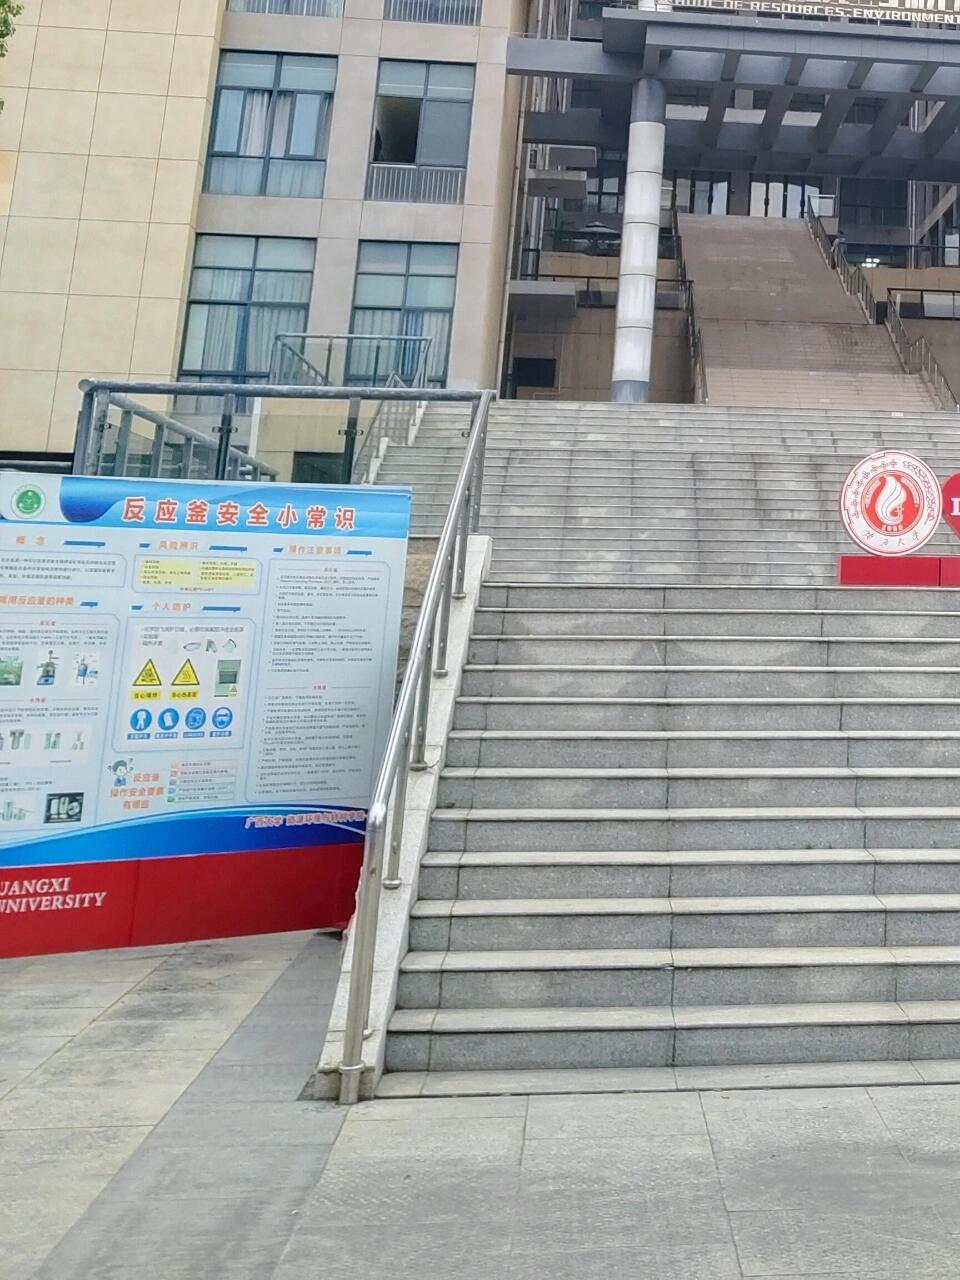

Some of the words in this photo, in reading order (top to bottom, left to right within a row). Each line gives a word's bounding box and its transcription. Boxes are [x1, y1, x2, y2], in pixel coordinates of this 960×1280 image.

[122, 497, 356, 530] 反应釜安全小常识
